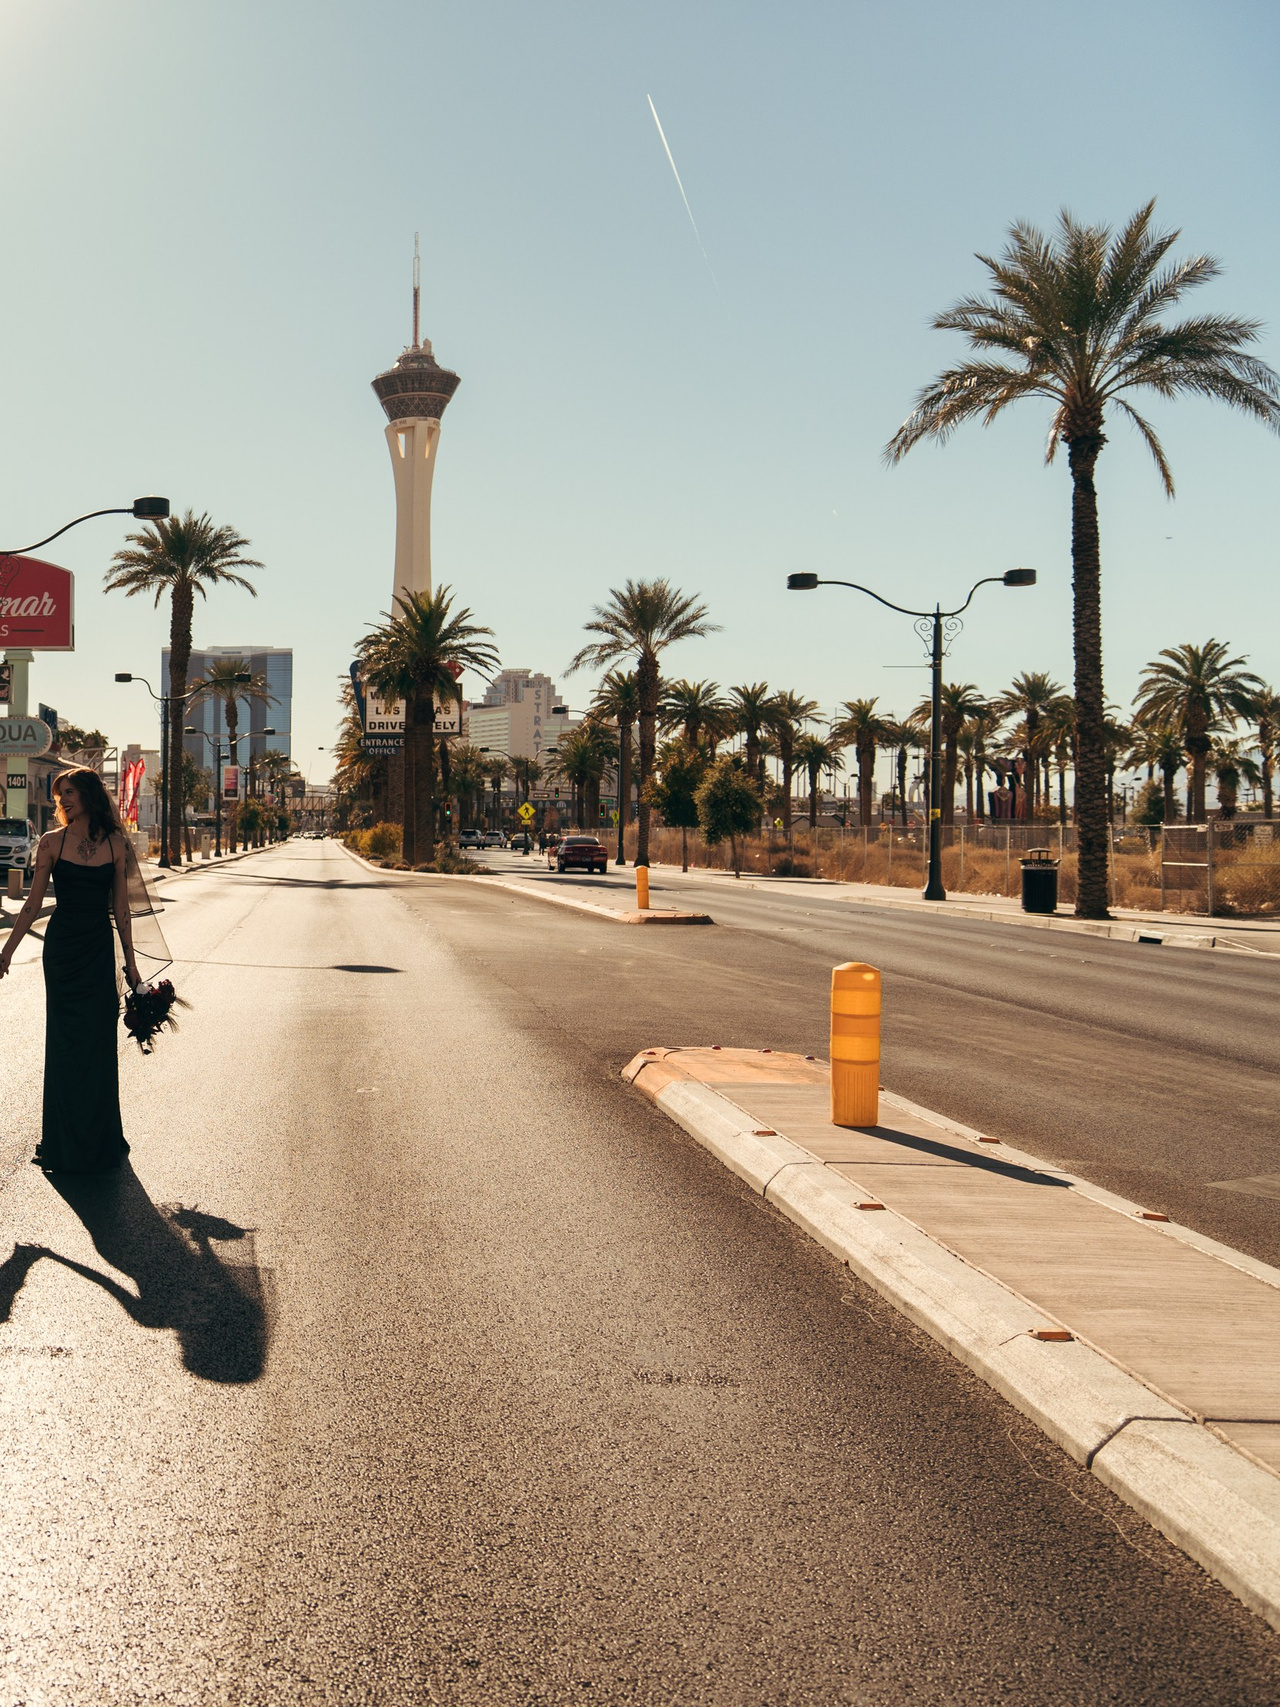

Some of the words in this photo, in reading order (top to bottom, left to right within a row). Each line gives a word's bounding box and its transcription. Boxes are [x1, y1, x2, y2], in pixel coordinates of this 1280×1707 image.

[376, 706, 400, 715] LAS
[533, 690, 542, 752] STRAT
[360, 738, 405, 747] ENTRANCE
[369, 747, 396, 755] OFFICE
[8, 776, 26, 787] 1401
